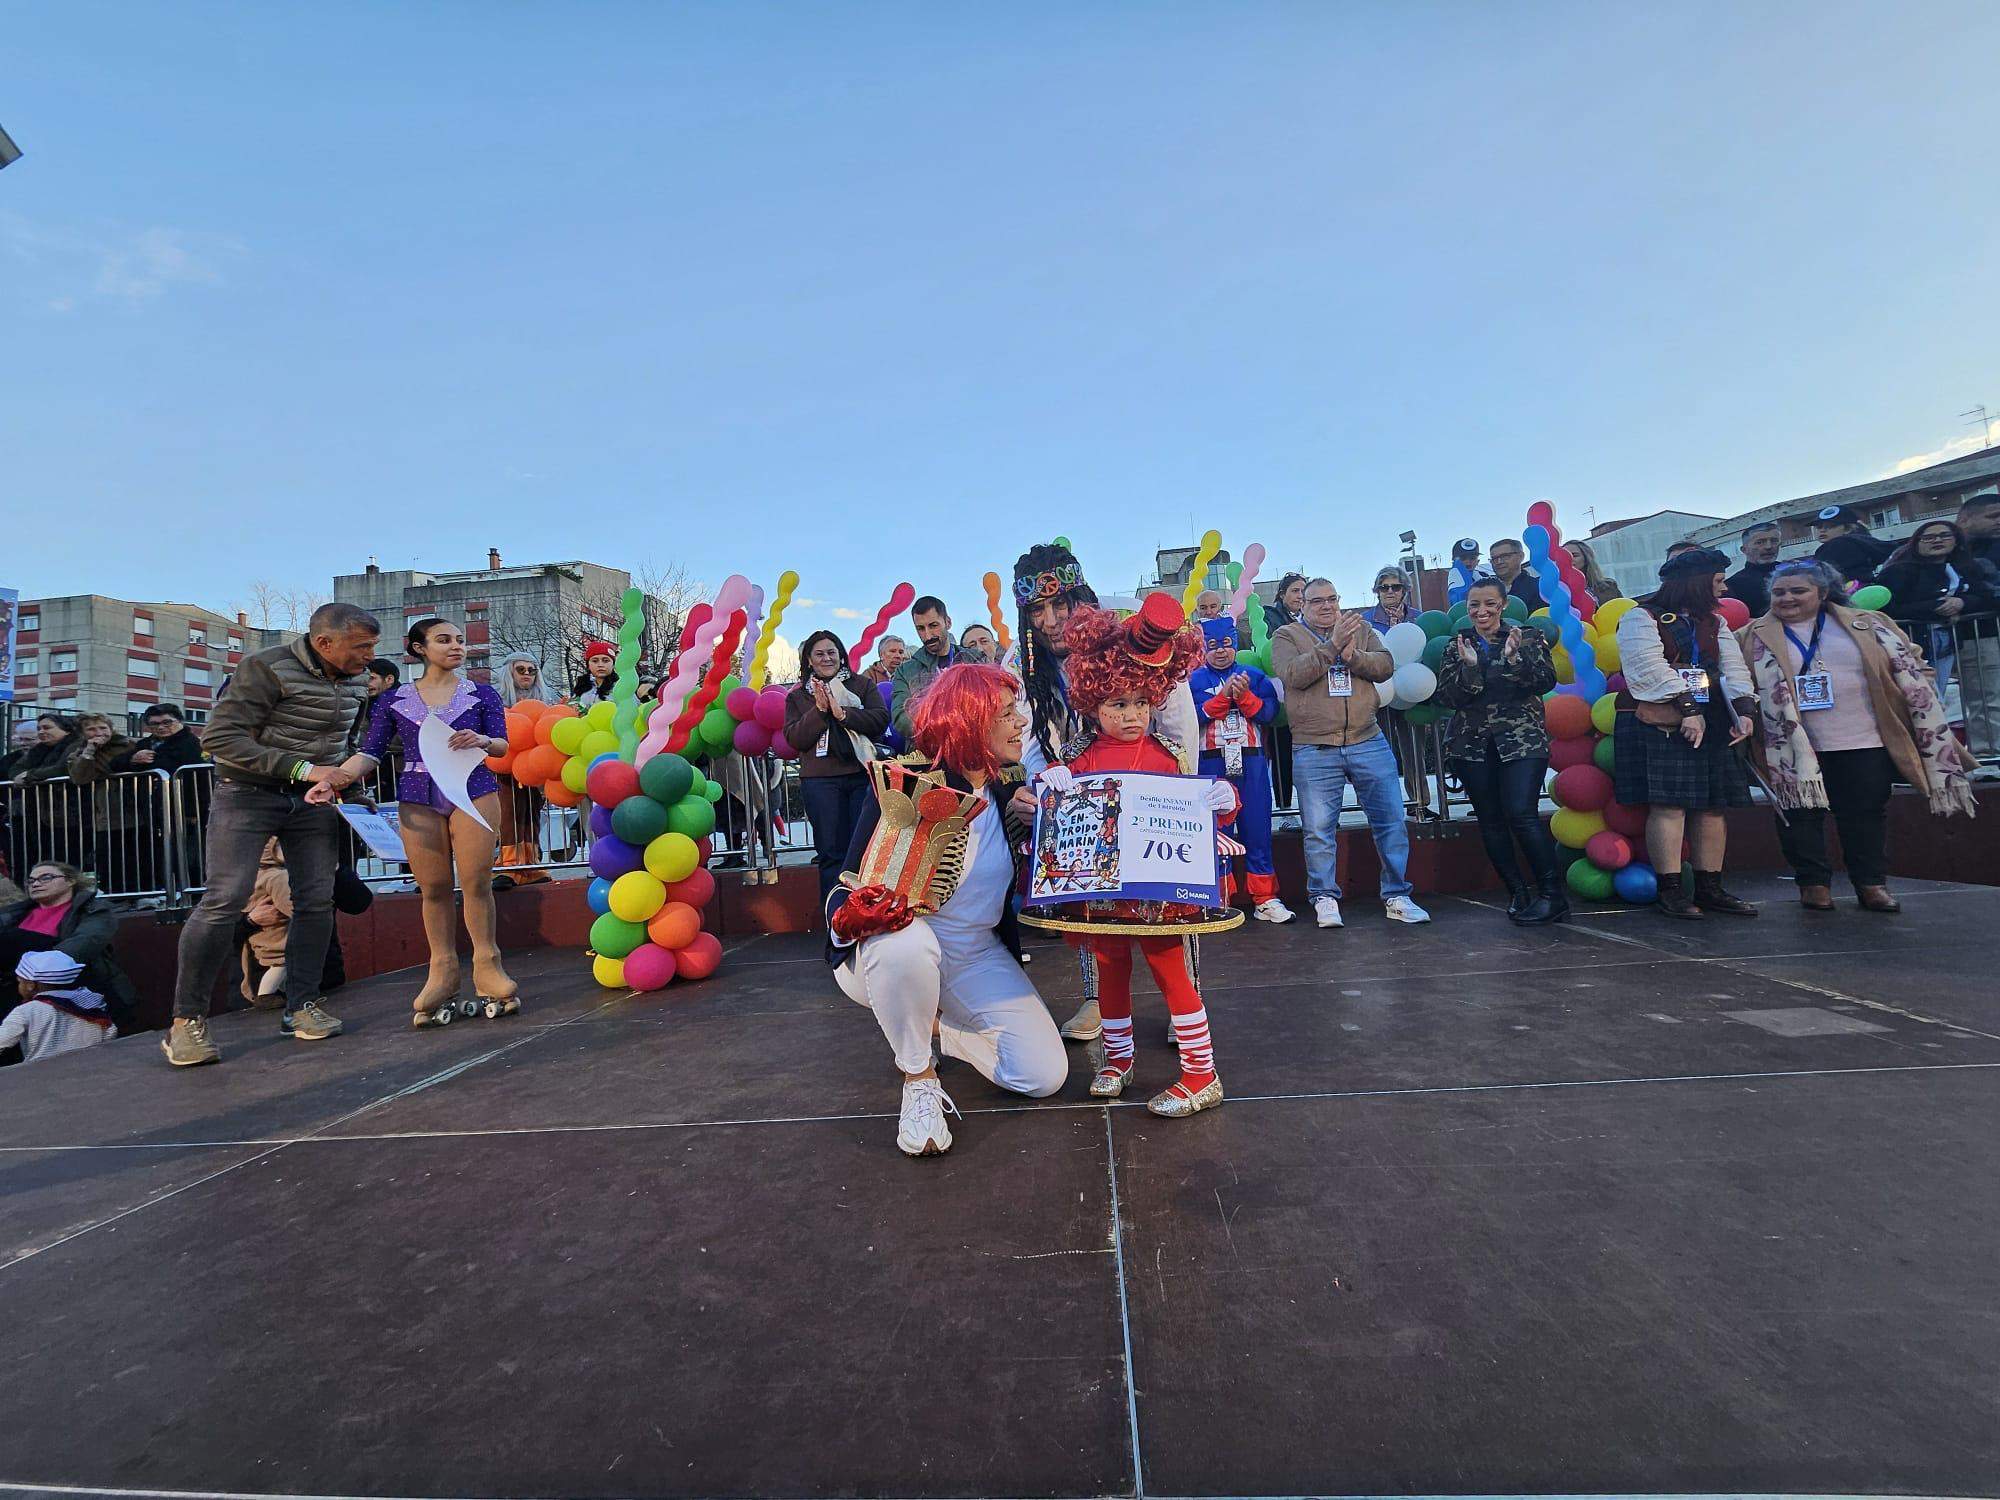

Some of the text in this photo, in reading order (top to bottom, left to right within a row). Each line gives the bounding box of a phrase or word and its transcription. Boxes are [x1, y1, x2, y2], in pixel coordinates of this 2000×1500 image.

[1140, 795, 1162, 803] Desfile
[1070, 813, 1088, 824] EN-
[1149, 816, 1203, 833] PREMIO
[1061, 824, 1098, 837] TROIDO
[1059, 833, 1096, 851] MARÍN
[1061, 849, 1090, 861] 2025
[1142, 839, 1192, 864] 70€
